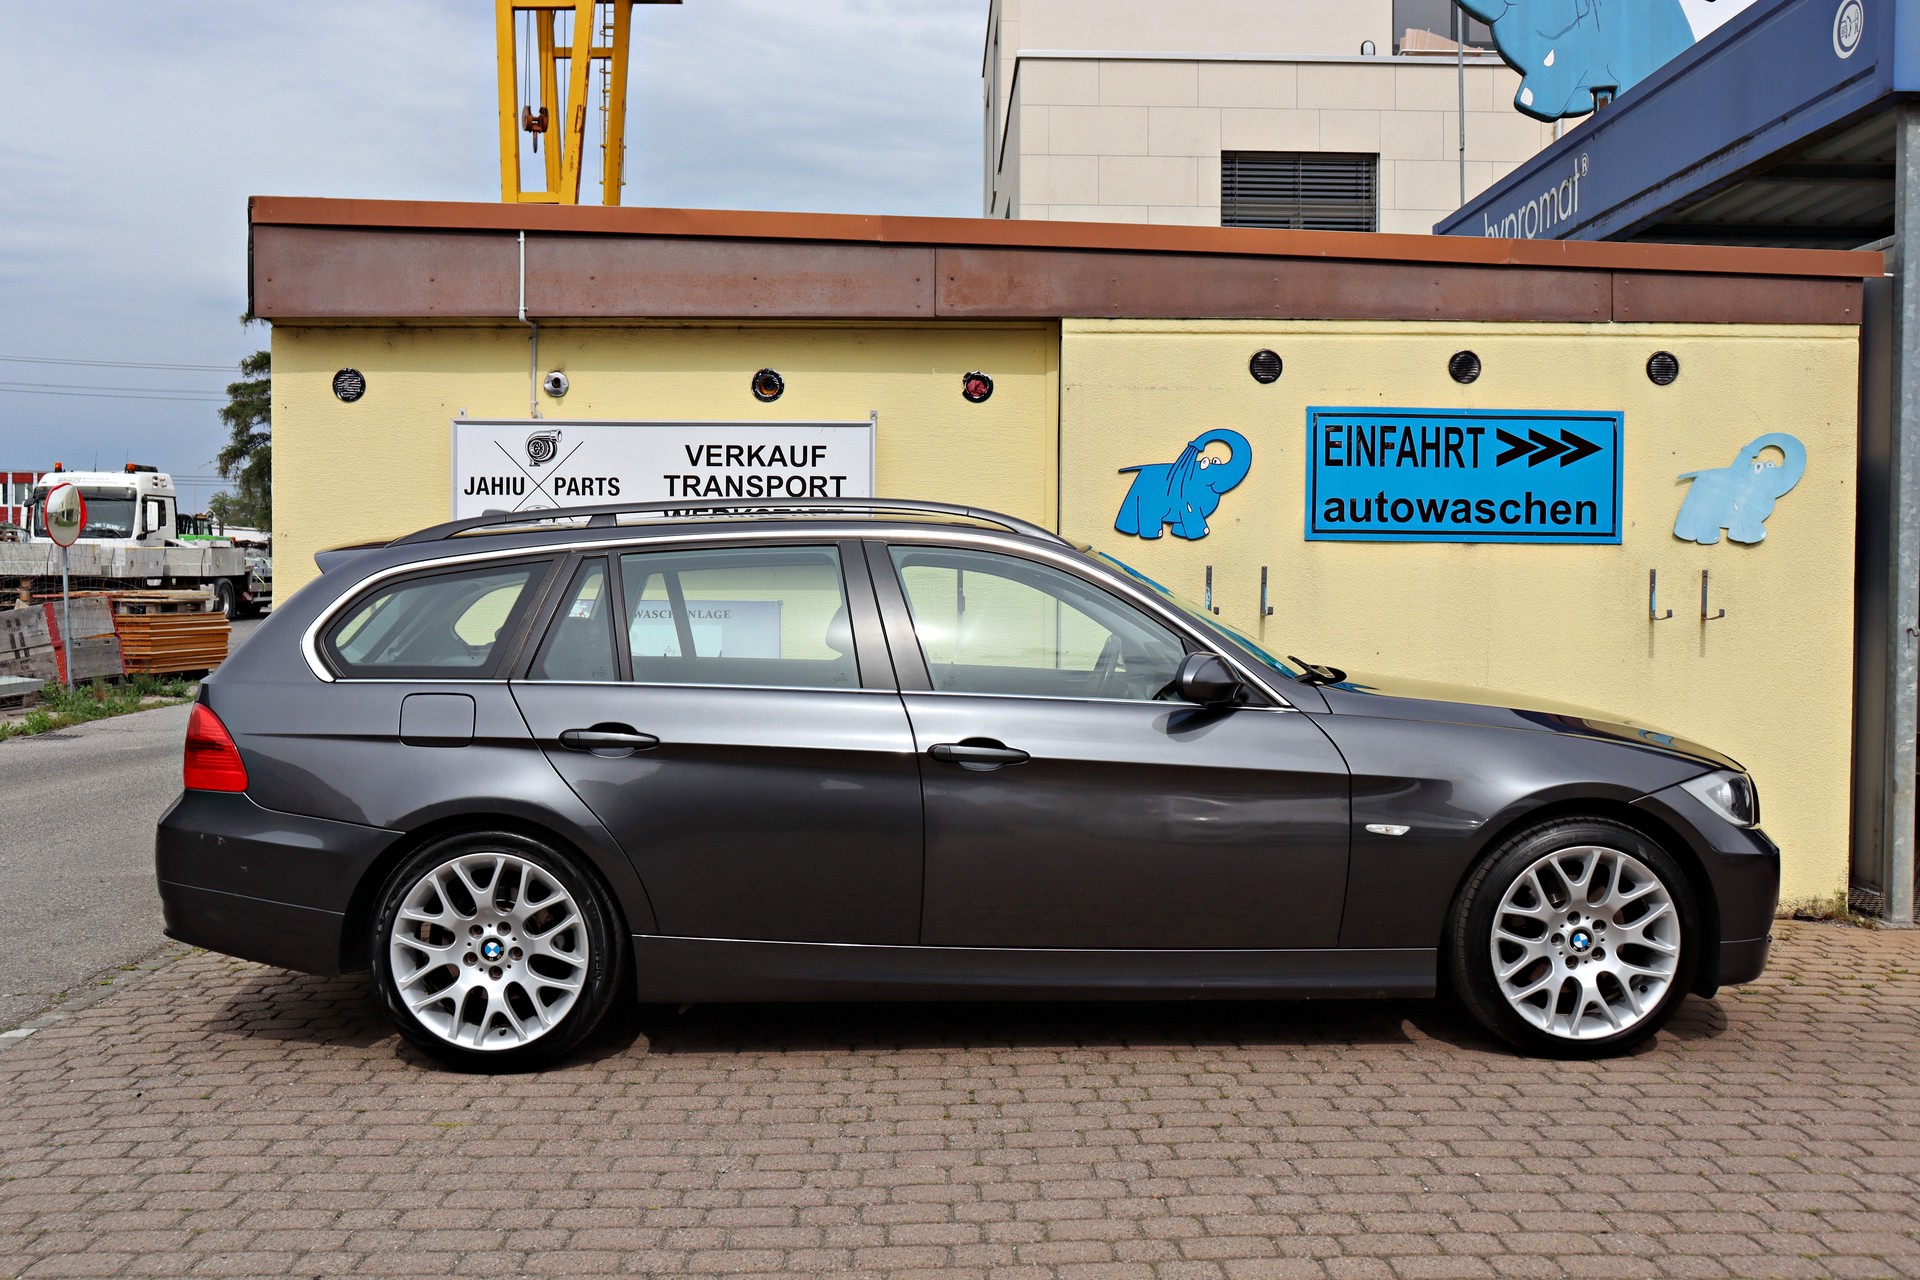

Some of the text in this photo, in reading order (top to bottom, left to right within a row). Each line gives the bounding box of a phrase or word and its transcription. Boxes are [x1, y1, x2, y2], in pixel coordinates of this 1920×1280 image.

[685, 444, 827, 468] VERKAUF
[1324, 425, 1485, 469] EINFAHRT
[464, 476, 620, 497] JAHIU PARTS
[664, 474, 847, 498] TRANSPORT
[1323, 490, 1597, 526] autowaschen
[634, 609, 731, 619] WASCNLAGE
